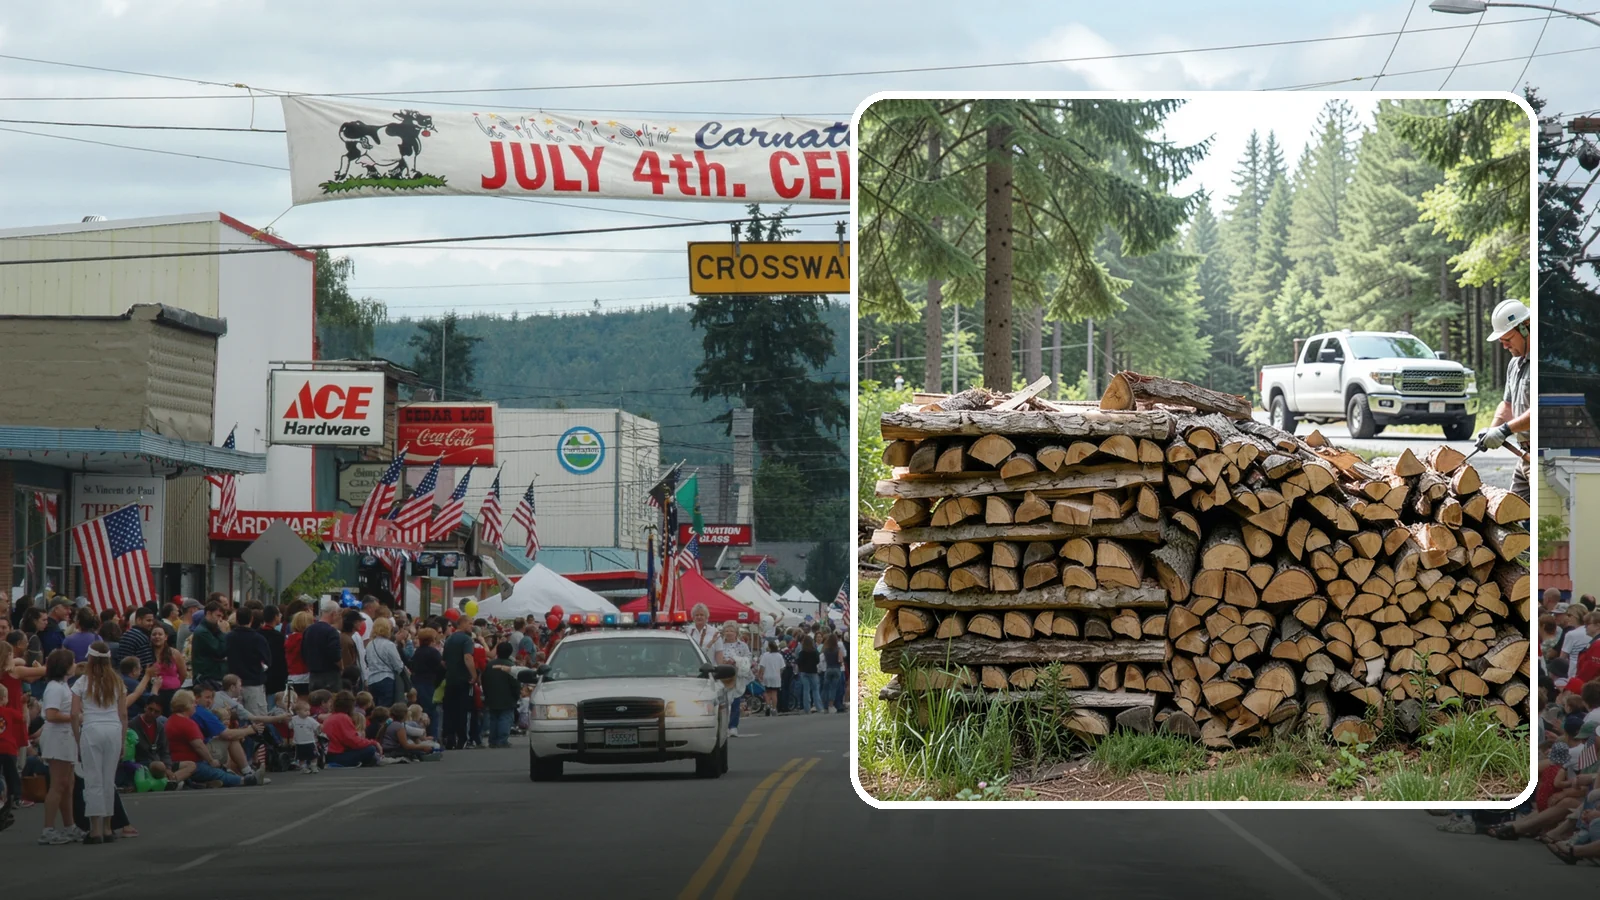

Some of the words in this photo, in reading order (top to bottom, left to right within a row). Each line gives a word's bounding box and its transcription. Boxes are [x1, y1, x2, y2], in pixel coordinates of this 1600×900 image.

[481, 140, 605, 192] JULY
[632, 150, 746, 198] 4th.
[697, 254, 850, 280] CROSSWA
[283, 380, 374, 420] ACE
[405, 409, 452, 422] CEDAR
[461, 409, 485, 422] LOG
[283, 421, 371, 436] Hardware
[353, 467, 385, 480] Simpl
[95, 485, 124, 494] Vincent
[126, 486, 135, 495] de
[137, 486, 155, 495] Paul
[213, 516, 331, 535] HARDARE
[688, 526, 741, 535] CRNATION
[700, 535, 730, 543] GLASS
